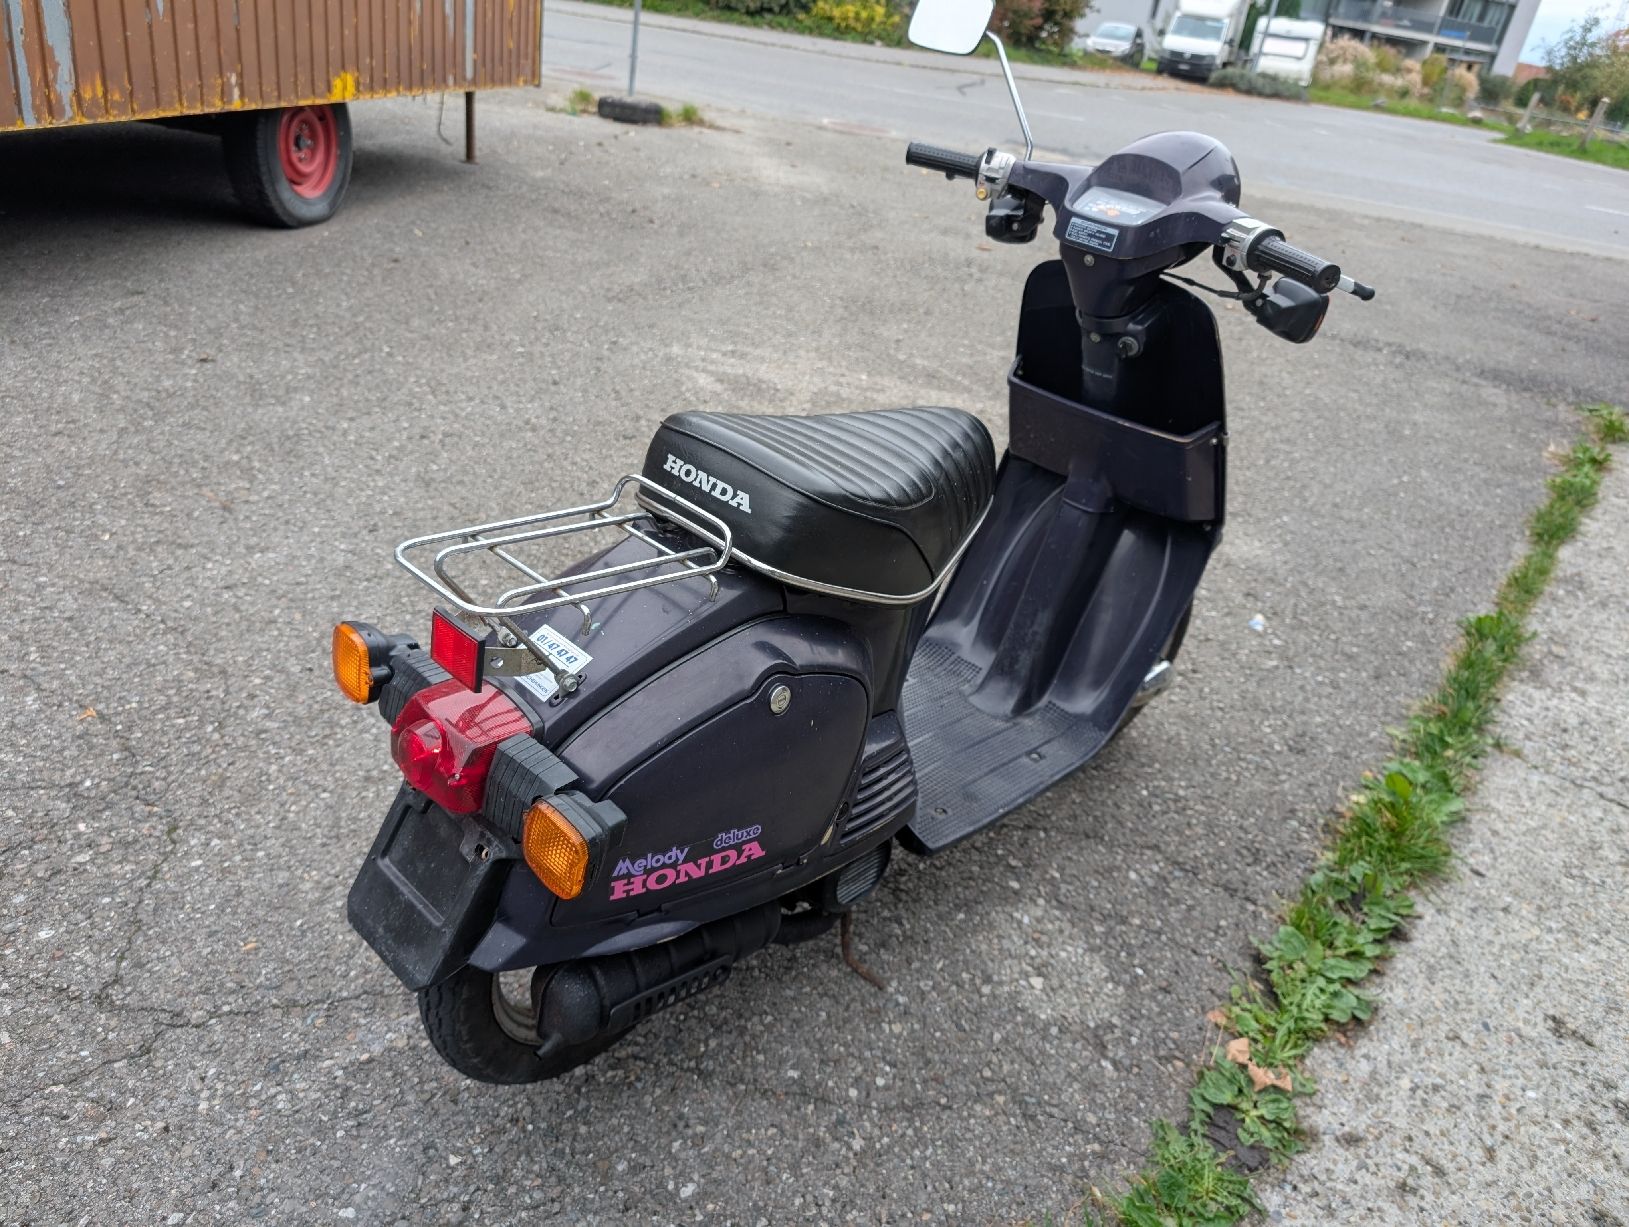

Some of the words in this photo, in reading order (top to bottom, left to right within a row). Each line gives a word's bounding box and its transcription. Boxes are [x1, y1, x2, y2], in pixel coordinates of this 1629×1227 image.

[663, 452, 752, 514] HONDA
[556, 648, 570, 658] 47
[565, 655, 579, 664] 47
[609, 840, 766, 901] HONDA
[611, 846, 690, 877] Melody
[713, 824, 762, 849] deluxe
